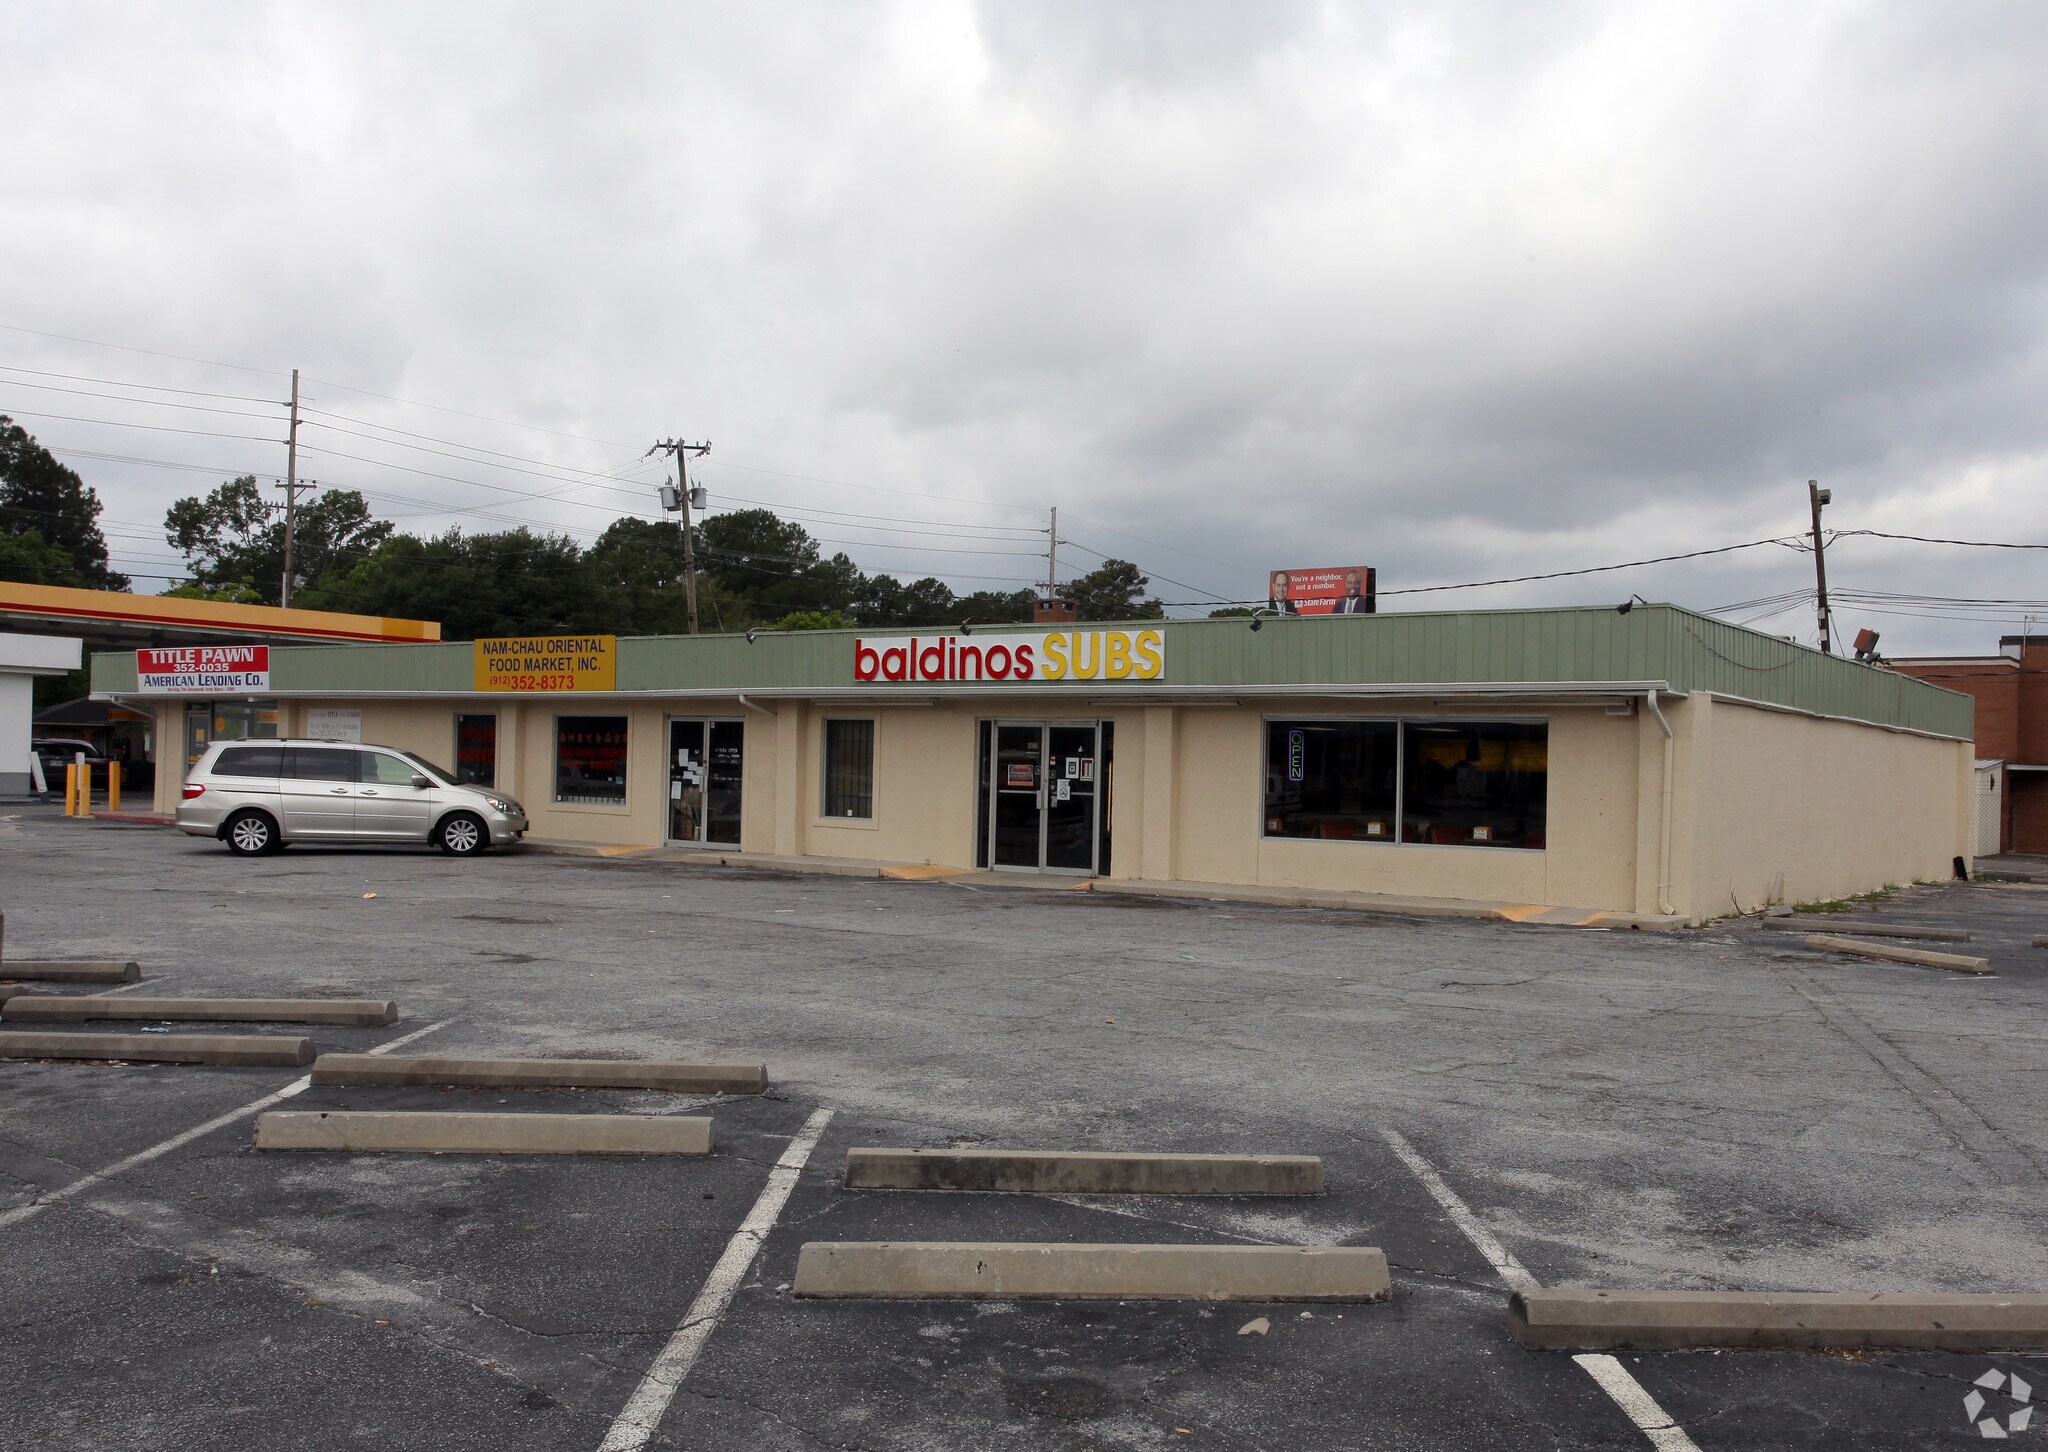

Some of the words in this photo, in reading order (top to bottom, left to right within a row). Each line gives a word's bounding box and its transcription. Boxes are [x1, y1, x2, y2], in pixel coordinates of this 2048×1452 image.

[149, 650, 196, 664] TITLE
[201, 647, 254, 663] PAWN
[483, 640, 544, 655] NAM-CHAU
[546, 639, 605, 653] ORIENTAL
[855, 636, 1034, 681] baldinos
[1041, 630, 1163, 680] SUBS
[173, 663, 230, 672] 352-0035
[489, 658, 521, 672] FOOD
[524, 657, 575, 673] MARKET,
[577, 656, 601, 671] INC.
[1292, 733, 1302, 778] OPEN
